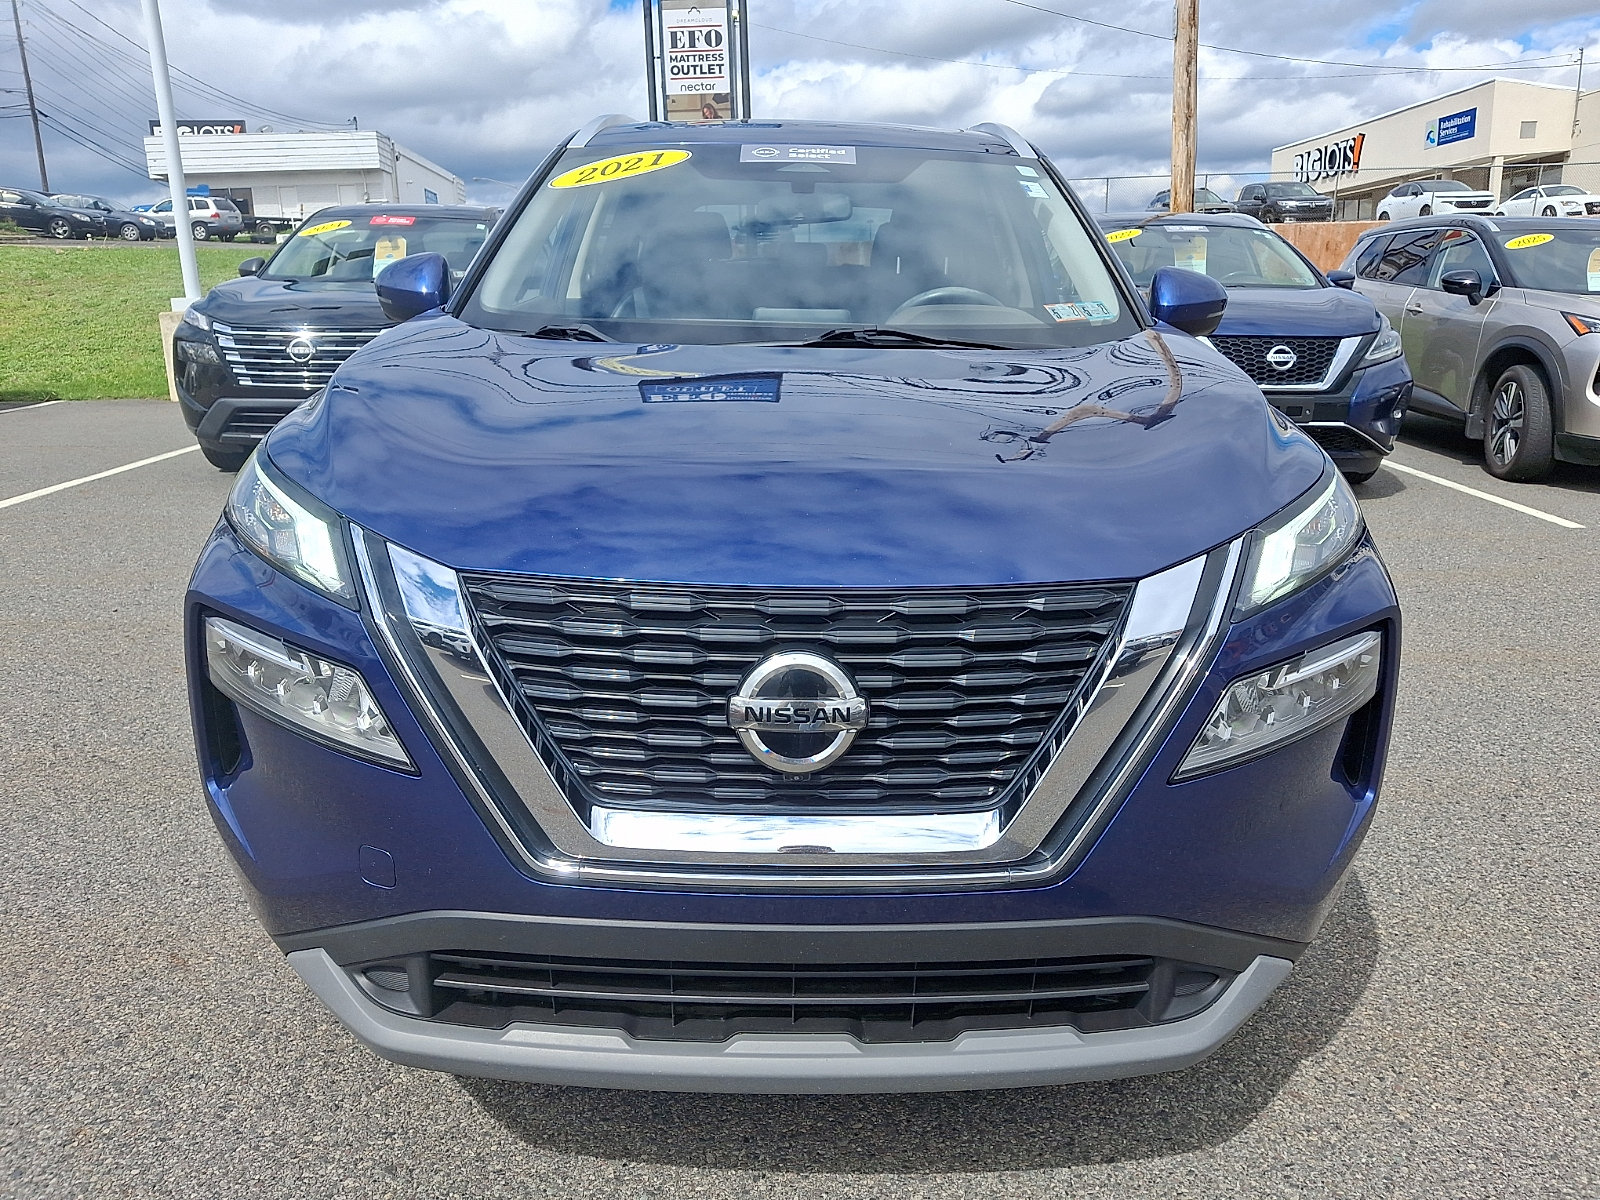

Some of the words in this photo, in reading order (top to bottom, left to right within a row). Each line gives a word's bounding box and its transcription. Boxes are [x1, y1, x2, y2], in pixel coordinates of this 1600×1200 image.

[669, 29, 723, 49] EFO
[669, 53, 724, 63] MATTRESS
[670, 64, 724, 76] OUTLET
[680, 83, 716, 92] nectar
[1440, 115, 1471, 129] Rehabilitation
[1440, 127, 1458, 136] Services
[788, 147, 846, 155] Certified
[575, 152, 665, 184] 2021
[744, 706, 851, 724] NISSAN
